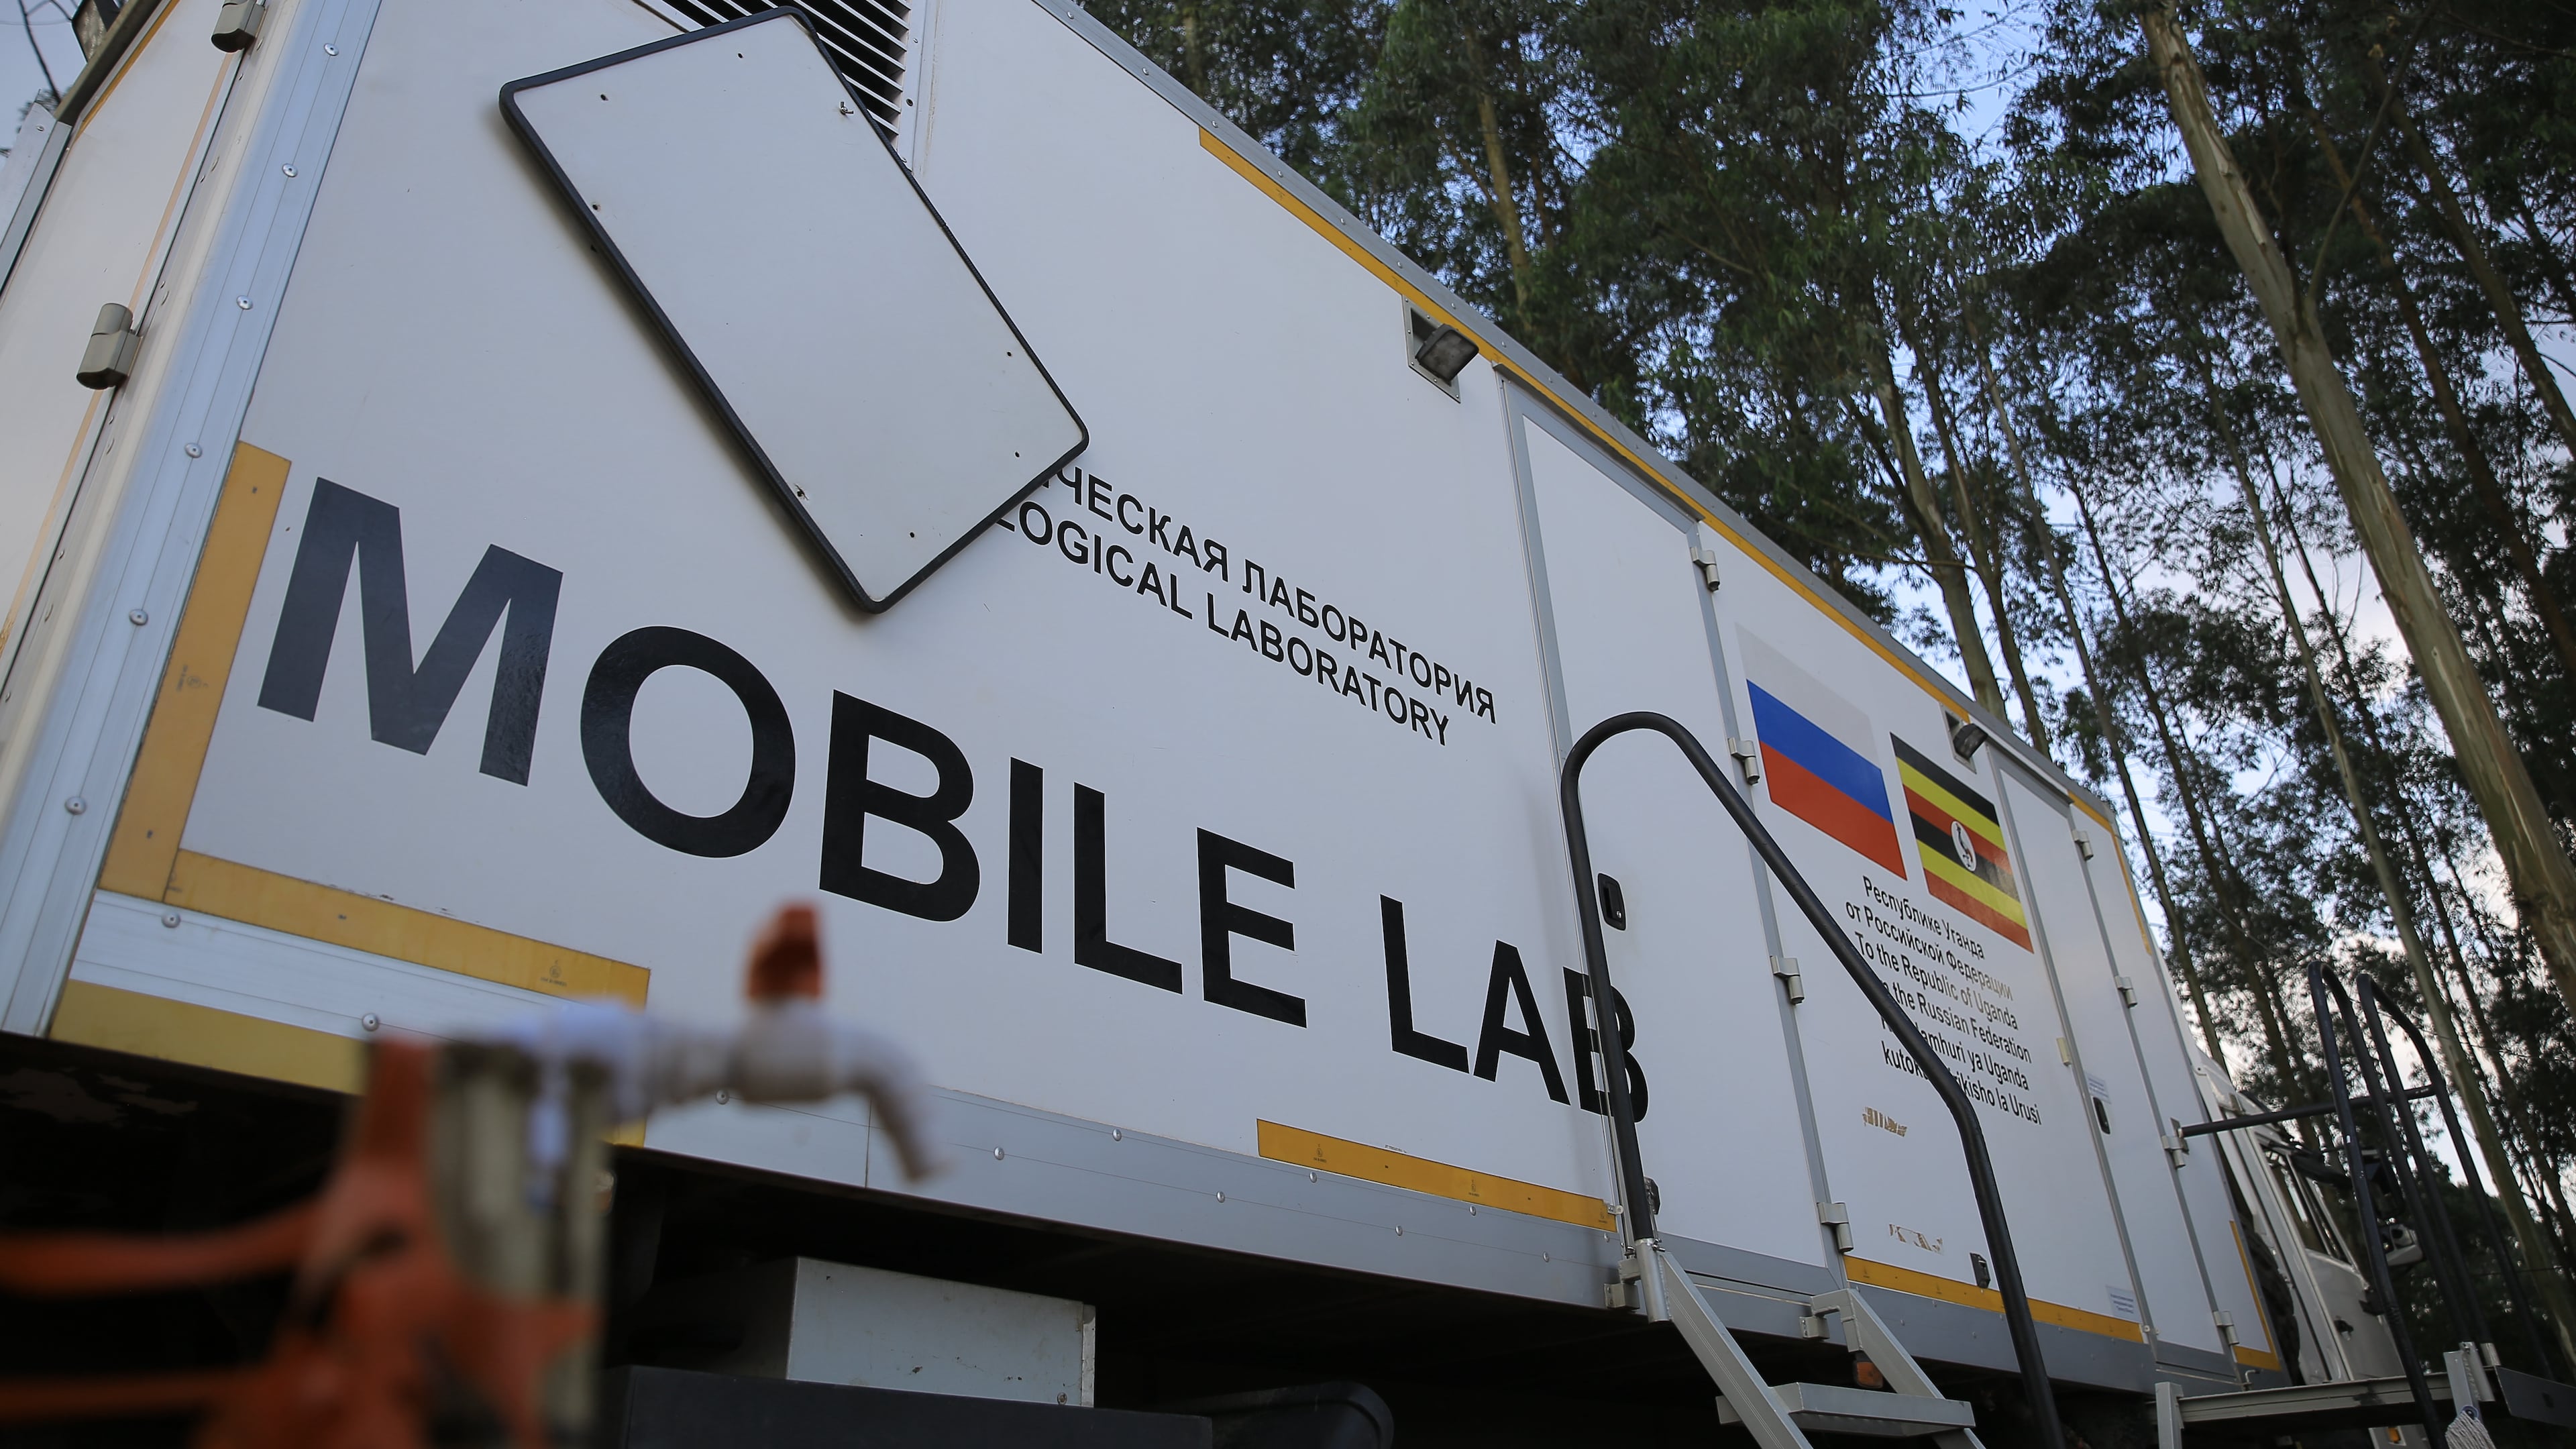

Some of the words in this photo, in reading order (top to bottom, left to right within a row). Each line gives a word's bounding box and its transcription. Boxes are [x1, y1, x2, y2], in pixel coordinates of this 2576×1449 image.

[996, 500, 1193, 619] OGICAL
[1206, 592, 1449, 746] LABORATORY
[1042, 466, 1229, 582] ЧЕСКАЯ
[1242, 558, 1497, 724] ЛАБОРАТОРИЯ
[258, 476, 1307, 1028] MOBILE
[1379, 894, 1649, 1124] LAB
[1845, 901, 1862, 922] от
[1863, 905, 1945, 965] Российской
[1946, 950, 2014, 1002] Федерации
[1863, 875, 1941, 936] Республике
[1943, 918, 1985, 960] Уганда
[1855, 931, 1874, 961] To
[1876, 943, 1899, 973] the
[1901, 953, 1958, 1001] Republic
[1960, 986, 1973, 1008] of
[1974, 989, 2019, 1030] Uganda
[1892, 981, 1916, 1011] the
[1916, 991, 1970, 1035] Russian
[1970, 1017, 2032, 1064] Federation
[1915, 1022, 1966, 1063] amhuri
[1967, 1049, 1984, 1073] ya
[1983, 1051, 2030, 1091] Uganda
[1996, 1087, 2010, 1113] la
[2009, 1093, 2042, 1126] Urusi
